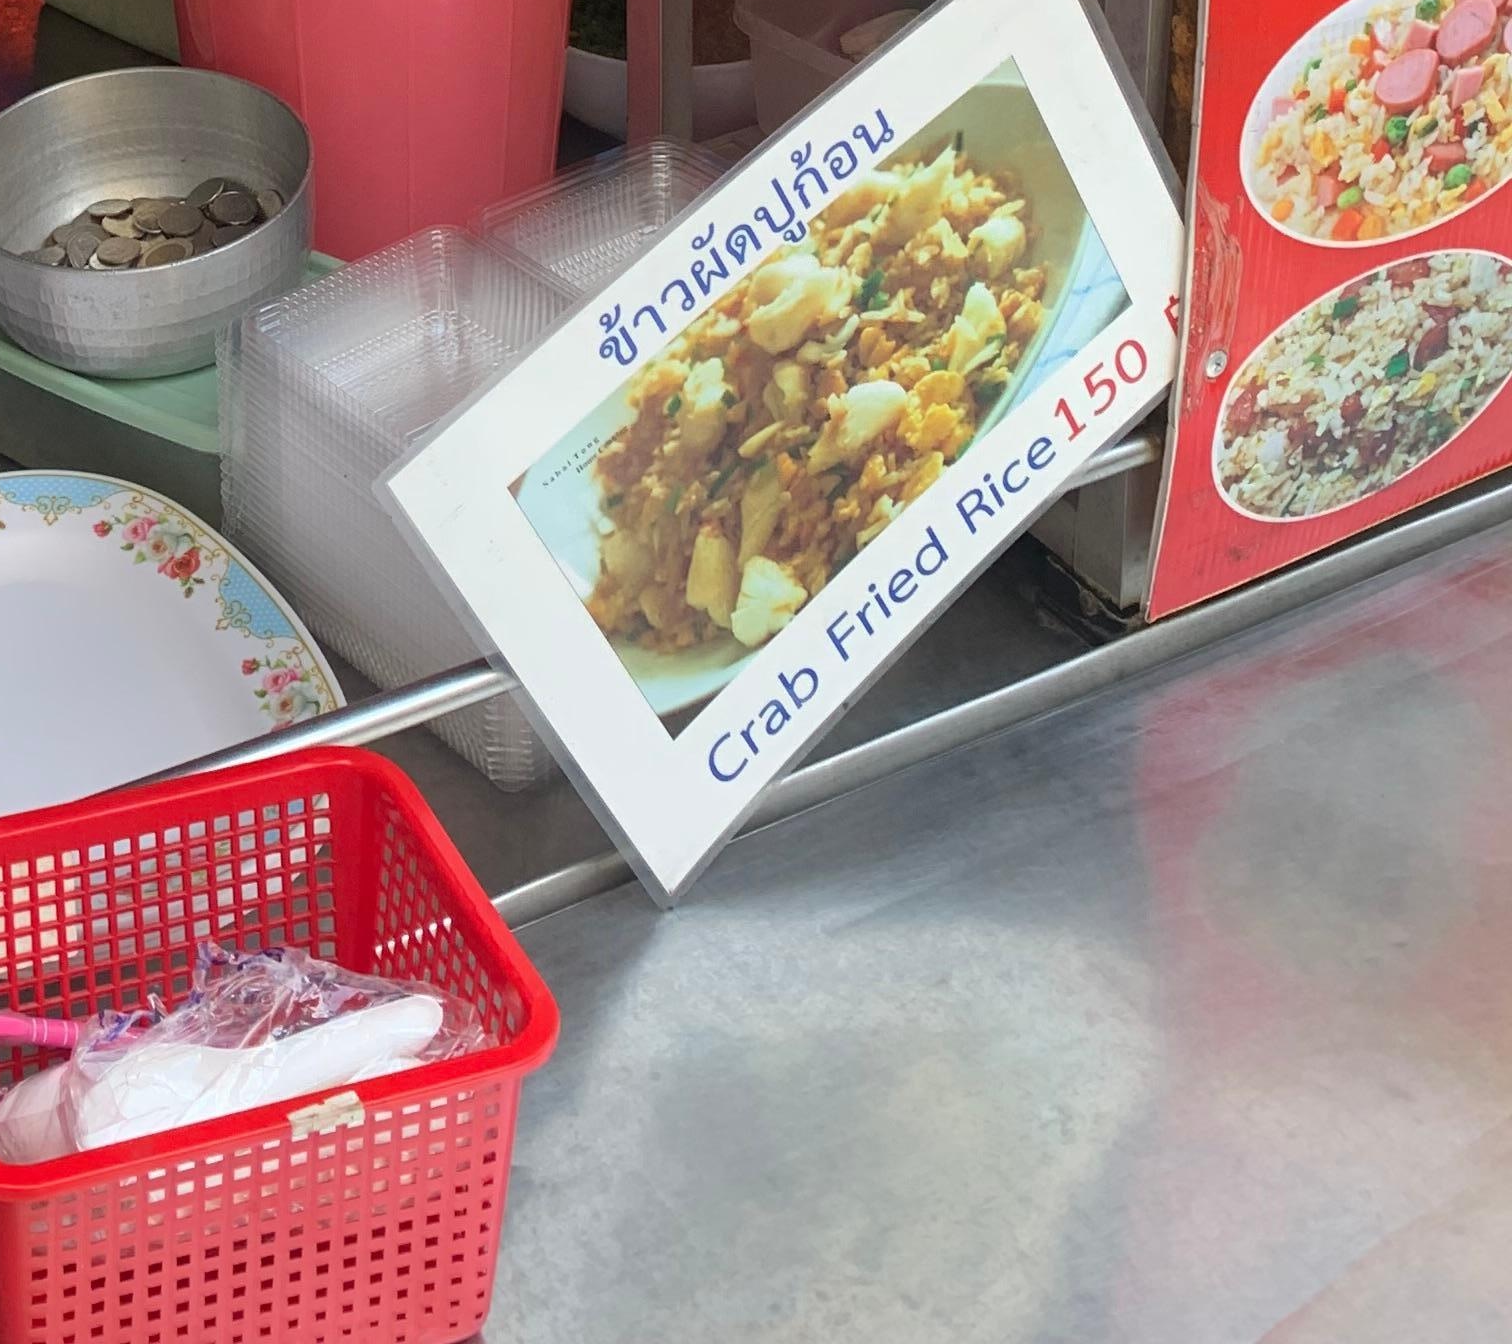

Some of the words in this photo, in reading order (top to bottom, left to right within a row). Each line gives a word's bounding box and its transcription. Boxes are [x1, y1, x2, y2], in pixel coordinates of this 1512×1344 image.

[596, 107, 896, 368] ข้าวผัดปูก้อน
[706, 665, 820, 783] Crab
[825, 525, 950, 662] Fried
[954, 435, 1057, 535] Rice
[1052, 338, 1149, 442] 150
